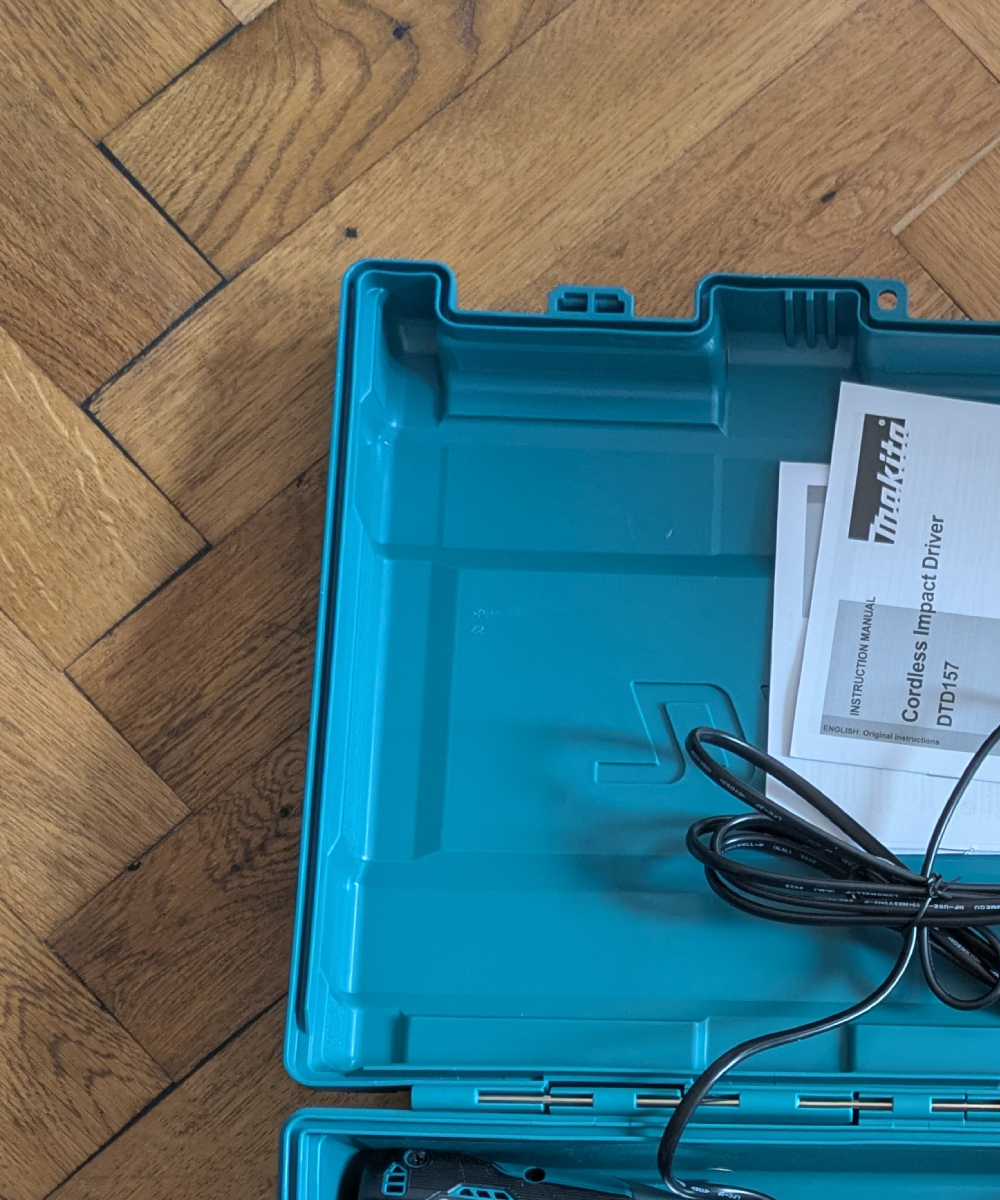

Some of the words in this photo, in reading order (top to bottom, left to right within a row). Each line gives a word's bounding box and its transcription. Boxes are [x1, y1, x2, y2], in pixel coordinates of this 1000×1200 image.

[922, 515, 944, 570] Driver
[913, 574, 937, 636] Impact
[850, 643, 869, 716] INSTRUCTION
[860, 596, 876, 641] MANUAL
[901, 640, 928, 723] Cordless
[936, 661, 960, 727] DTD157
[823, 724, 862, 738] ENGLISH:
[863, 729, 893, 742] Original
